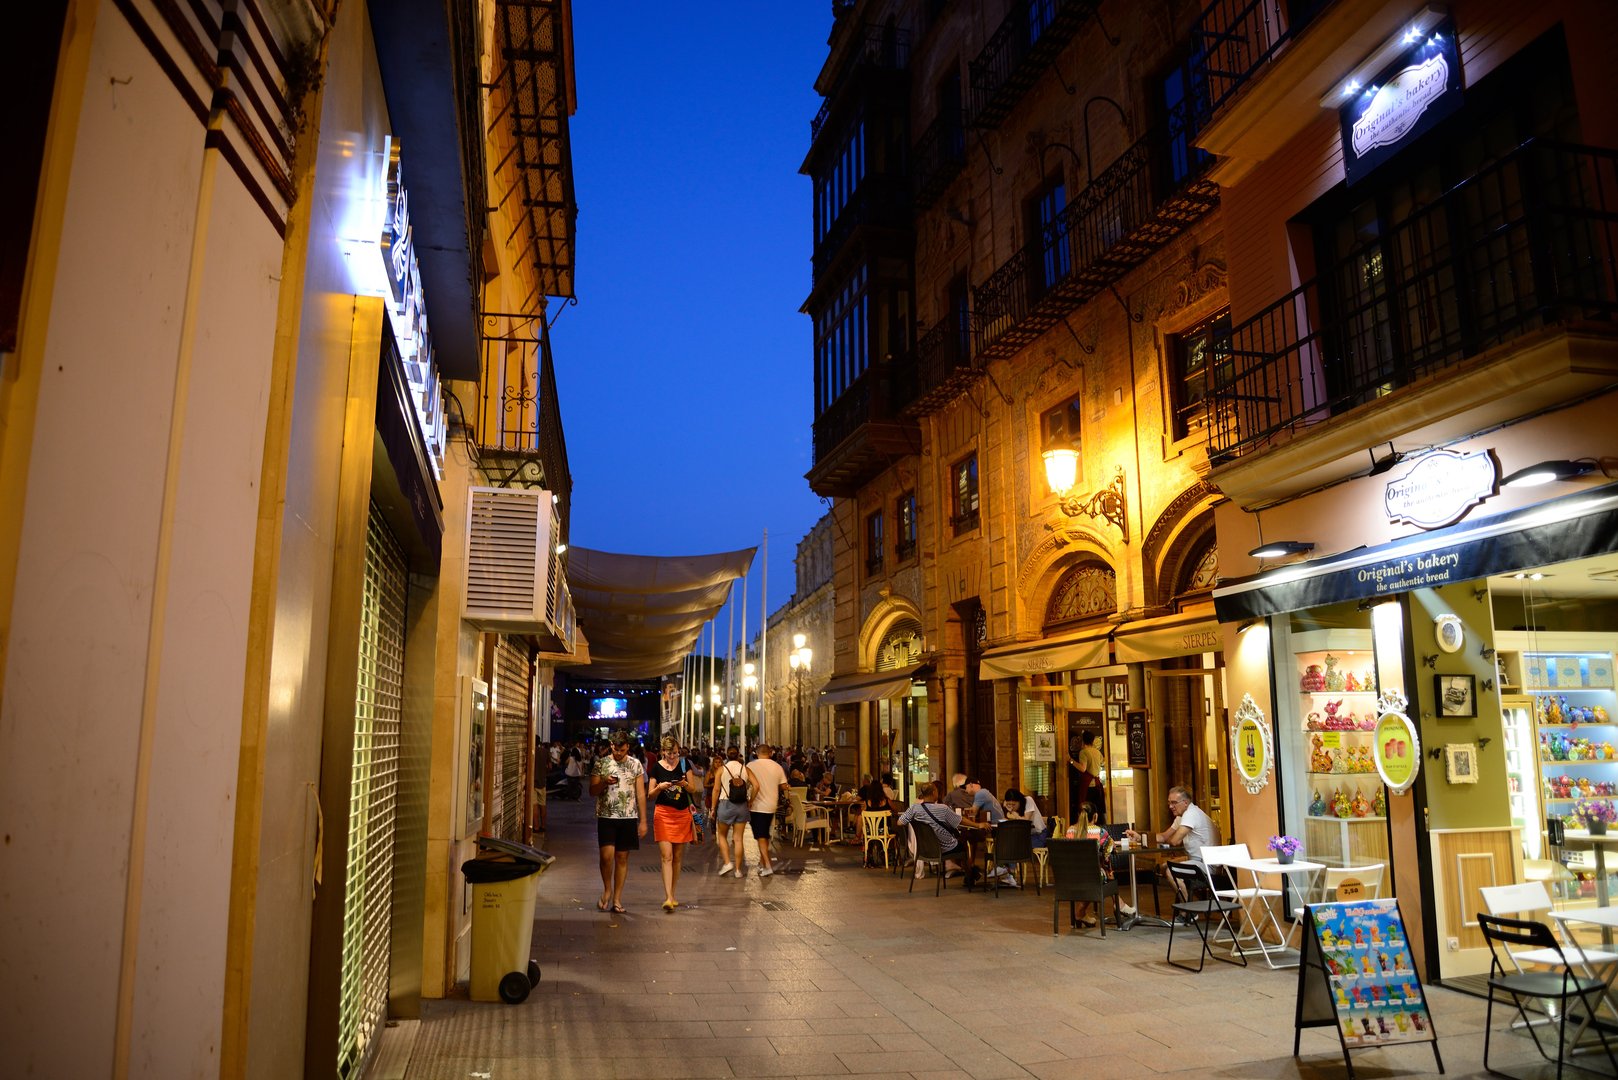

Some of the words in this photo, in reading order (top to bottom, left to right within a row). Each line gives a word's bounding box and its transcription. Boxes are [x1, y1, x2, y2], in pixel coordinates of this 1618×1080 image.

[1355, 97, 1404, 141] Original's
[1405, 66, 1443, 101] bakery
[1369, 130, 1380, 141] the
[1381, 105, 1411, 132] authentic
[1412, 87, 1433, 107] bread
[1357, 560, 1414, 583] Original's
[1417, 552, 1460, 571] bakery
[1376, 582, 1388, 592] the
[1389, 575, 1425, 590] authentic
[1426, 569, 1450, 583] bread
[1182, 631, 1217, 650] SIERPES
[1344, 888, 1359, 896] 2,50
